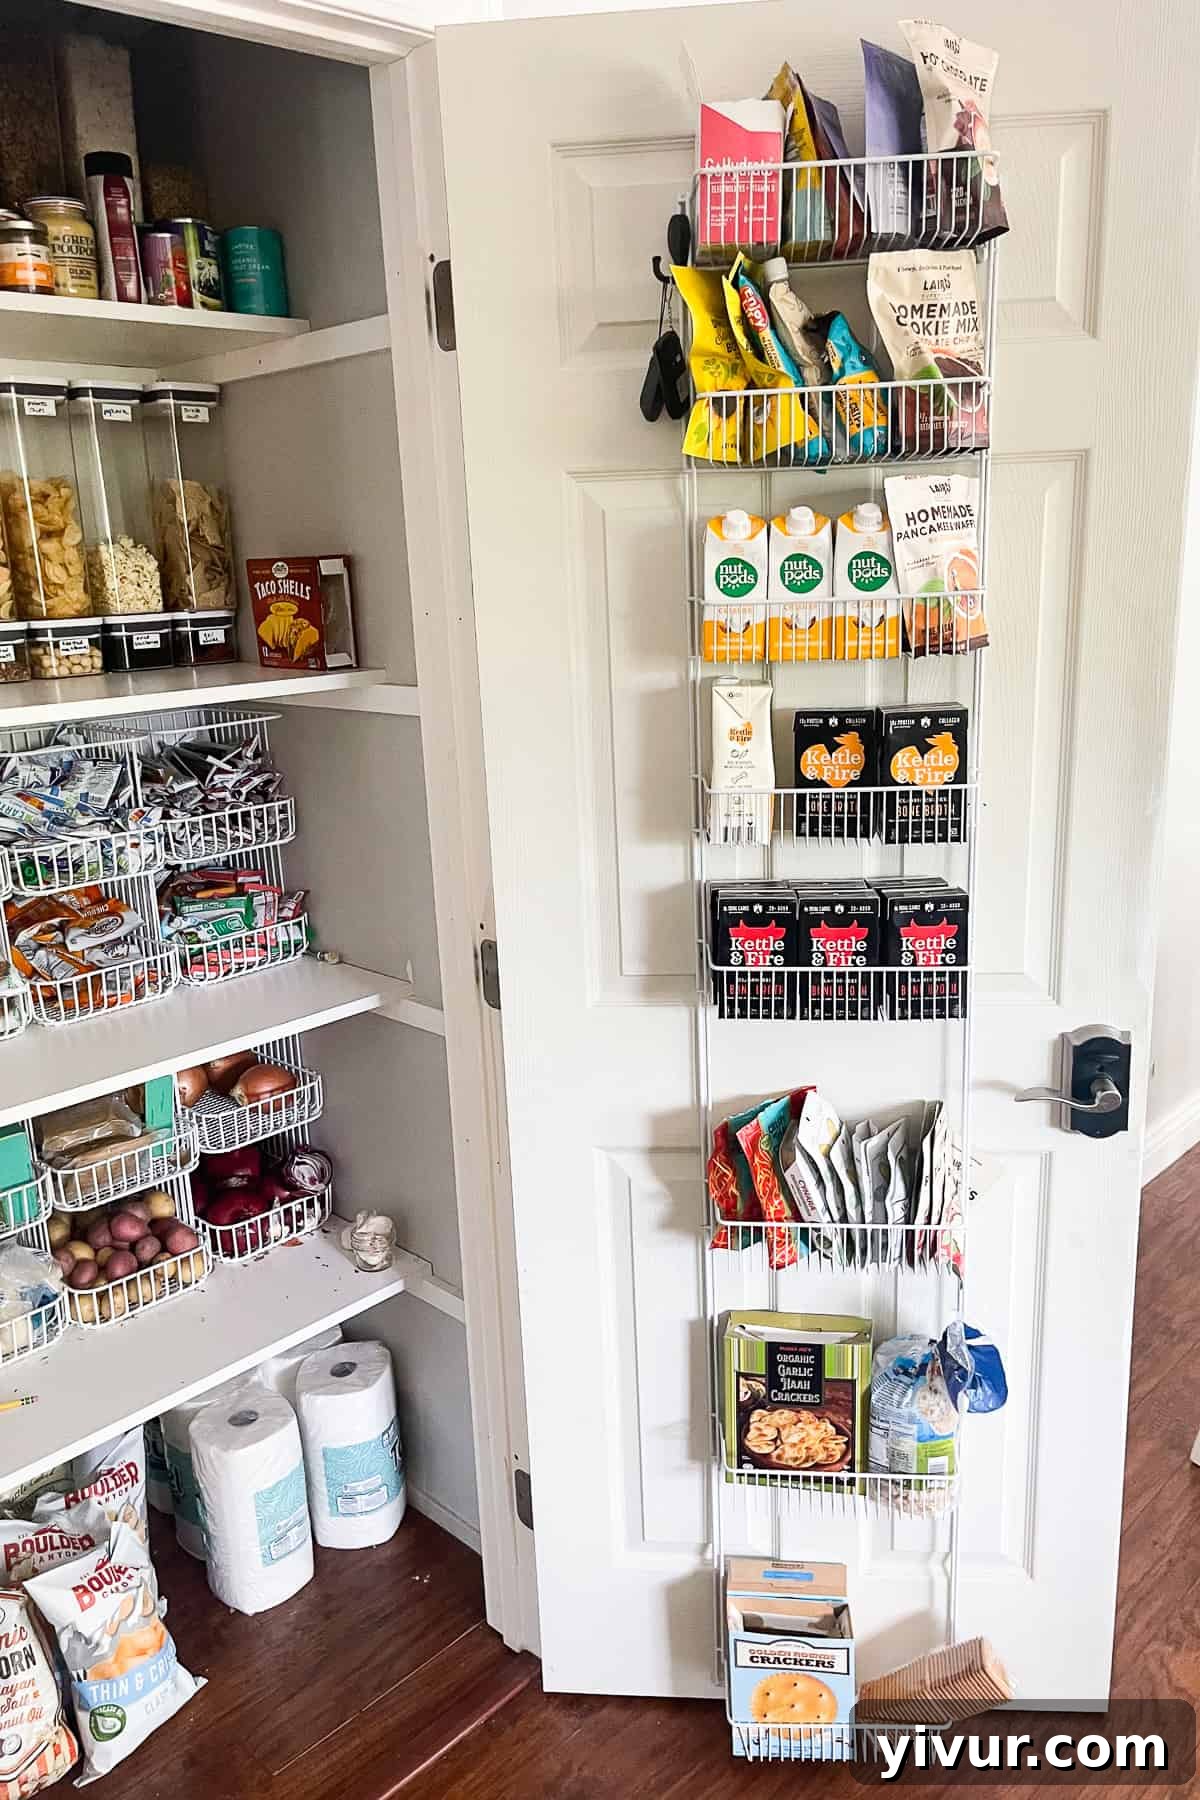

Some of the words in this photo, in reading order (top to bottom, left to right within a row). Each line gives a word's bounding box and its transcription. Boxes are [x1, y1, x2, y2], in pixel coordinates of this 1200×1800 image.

[719, 563, 743, 575] nut
[784, 558, 809, 571] nut
[852, 556, 877, 569] nut
[719, 571, 756, 589] pods
[784, 565, 820, 585] pods
[852, 563, 889, 583] pods
[254, 580, 277, 600] TACO
[278, 579, 312, 601] SHELLS
[806, 749, 862, 765] Kettle
[896, 749, 955, 768] Kettle
[806, 765, 819, 780] &
[821, 765, 862, 781] Fire
[897, 769, 911, 784] &
[914, 767, 955, 783] Fire
[729, 935, 785, 951] Kettle
[810, 936, 868, 952] Kettle
[901, 934, 957, 951] Kettle
[730, 951, 744, 966] &
[745, 951, 785, 966] Fire
[811, 952, 825, 967] &
[828, 951, 868, 967] Fire
[901, 951, 914, 966] &
[917, 950, 957, 966] Fire
[776, 1353, 816, 1364] ORGANIC
[777, 1364, 814, 1377] GARLIC
[770, 1389, 821, 1403] CRACKERS
[748, 1654, 836, 1669] CRACKERS
[89, 1677, 129, 1702] THIN
[135, 1676, 145, 1691] &
